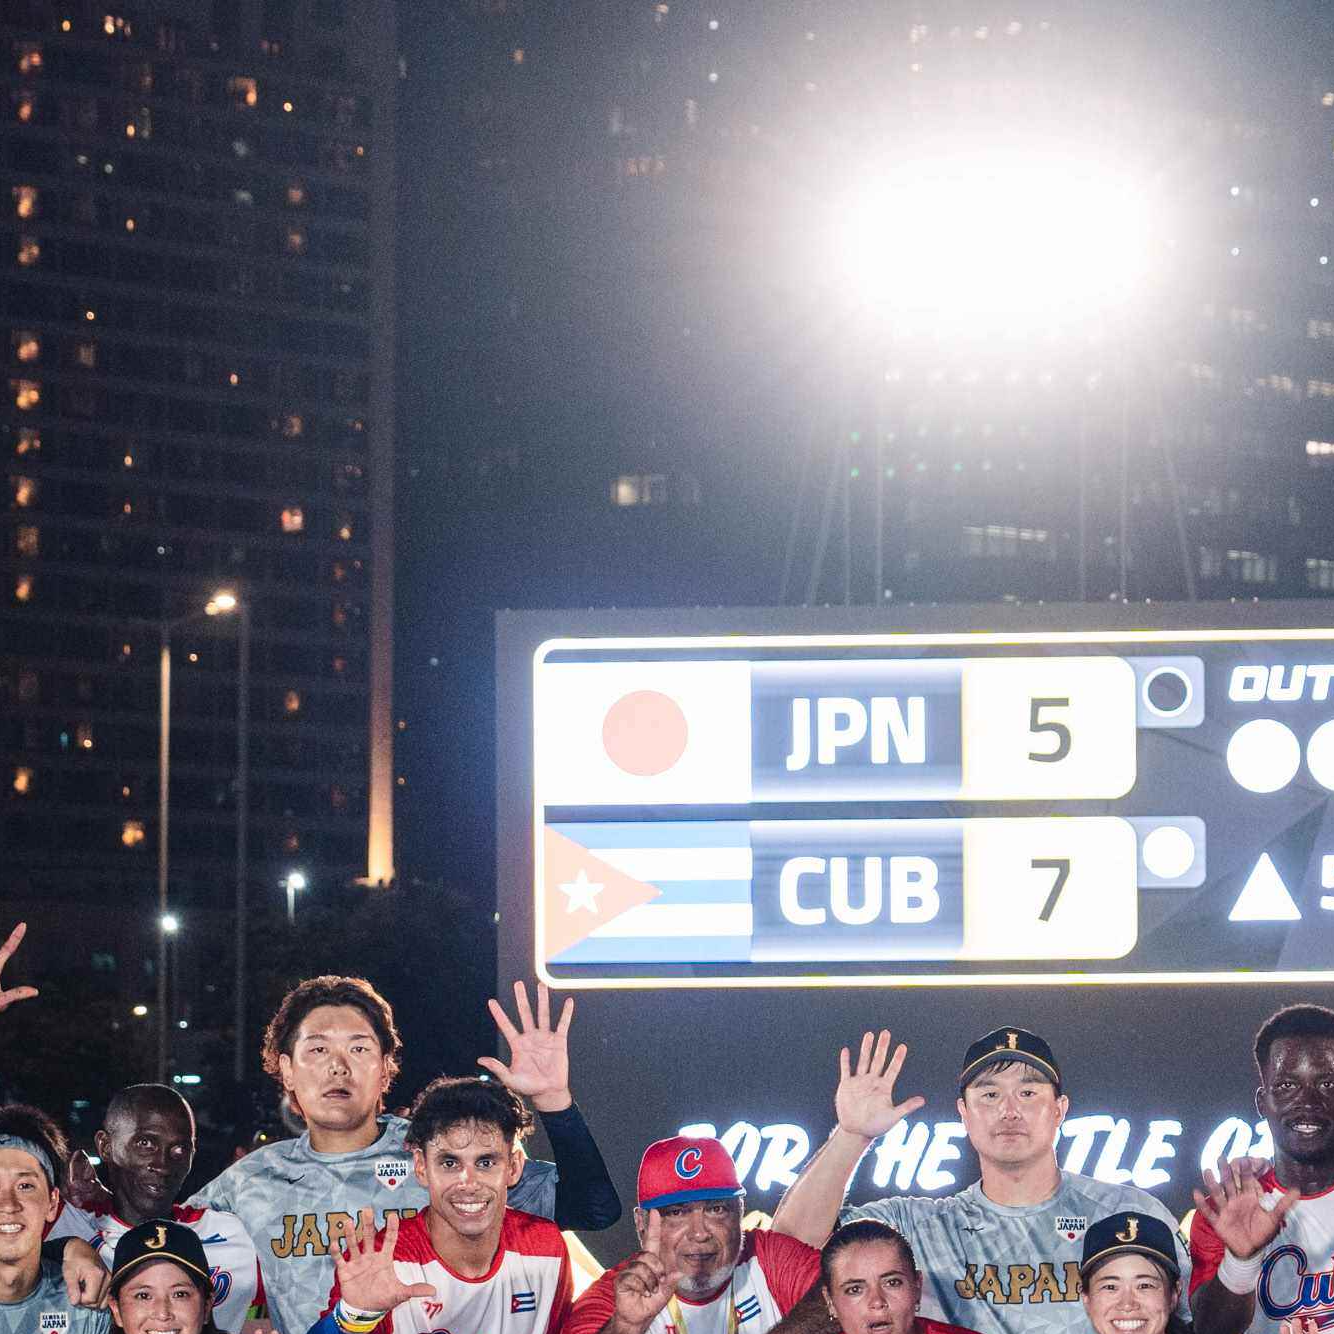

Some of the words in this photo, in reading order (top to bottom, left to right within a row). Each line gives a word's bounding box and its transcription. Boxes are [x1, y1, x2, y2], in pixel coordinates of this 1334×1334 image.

[786, 696, 927, 771] JPN
[1028, 697, 1072, 763] 5
[779, 855, 941, 926] CUB
[1030, 858, 1071, 922] 7
[378, 1167, 407, 1178] JAPAN
[674, 1147, 703, 1180] C
[144, 1226, 168, 1249] J
[1056, 1222, 1088, 1233] JAPAN
[1115, 1216, 1139, 1243] J
[41, 1319, 68, 1329] JAPAN
